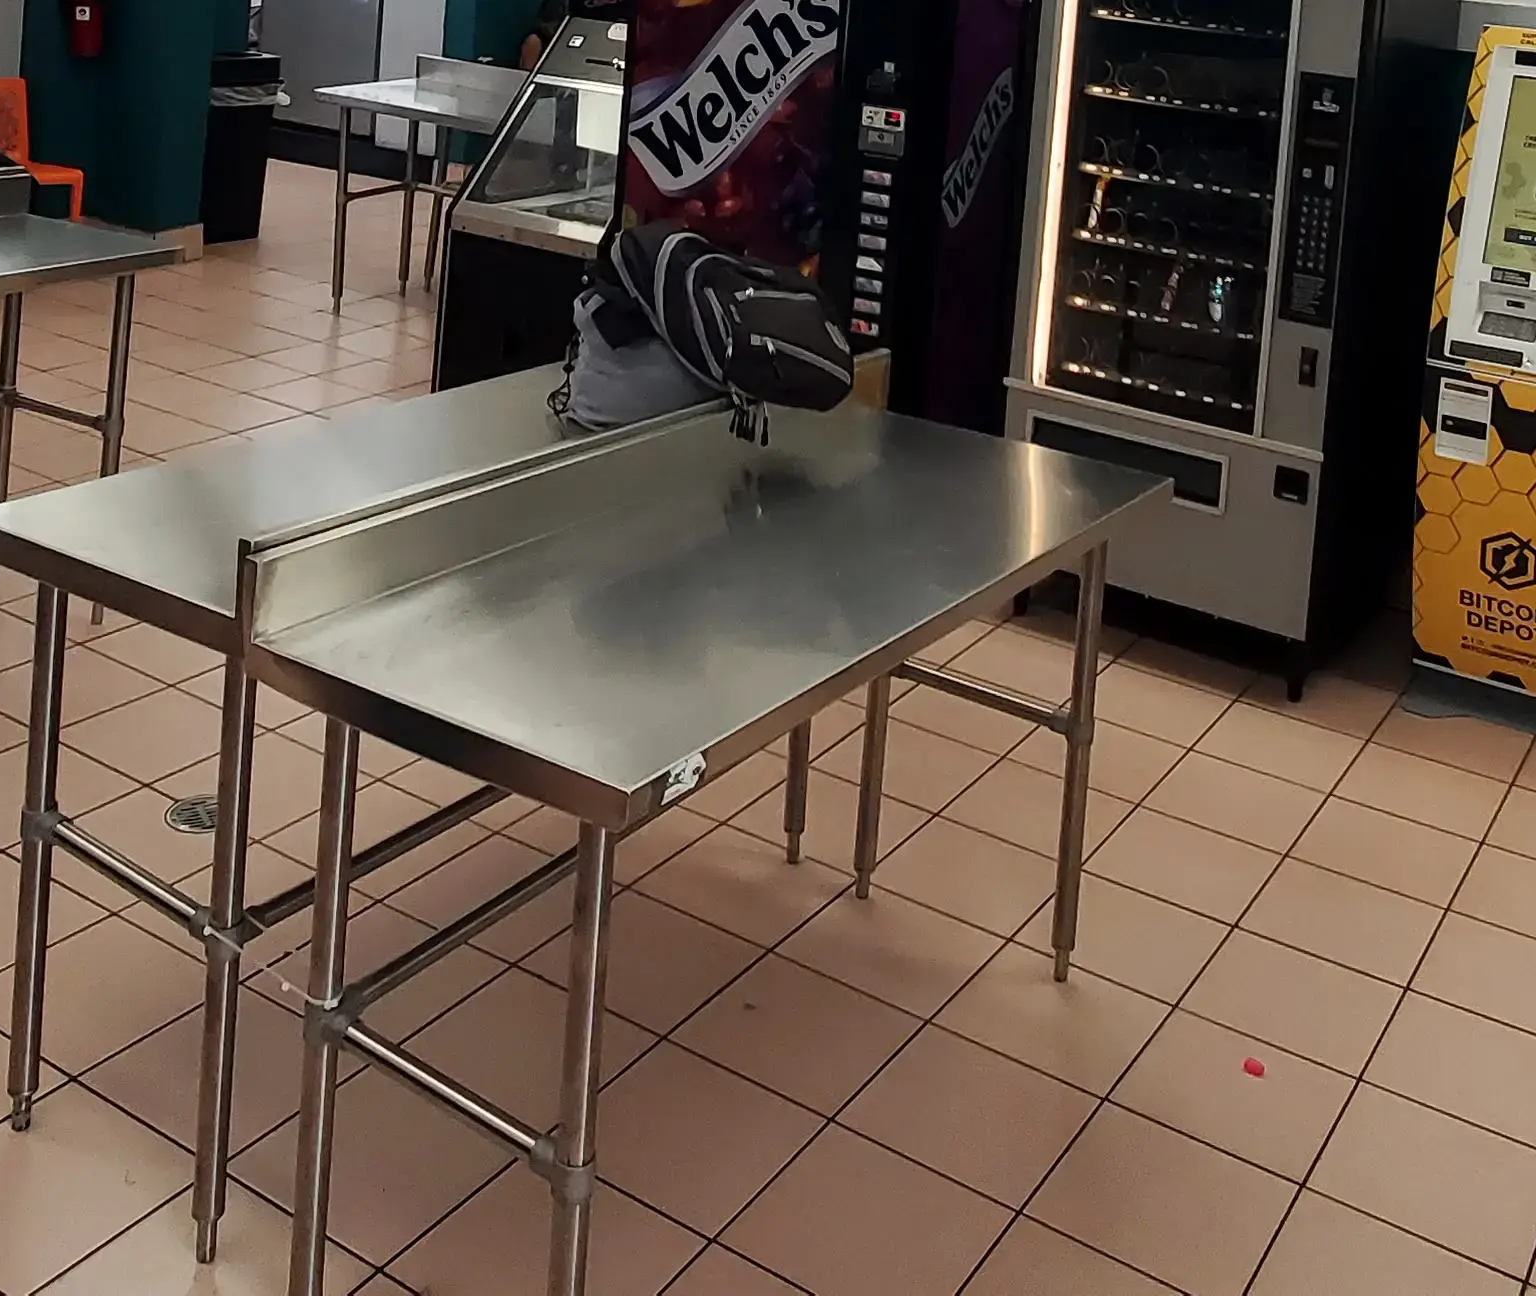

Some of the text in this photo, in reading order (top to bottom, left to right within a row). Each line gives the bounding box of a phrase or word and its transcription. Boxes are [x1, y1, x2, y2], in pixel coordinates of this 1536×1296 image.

[730, 73, 787, 145] SINCE 1869
[942, 83, 1013, 219] Welch's
